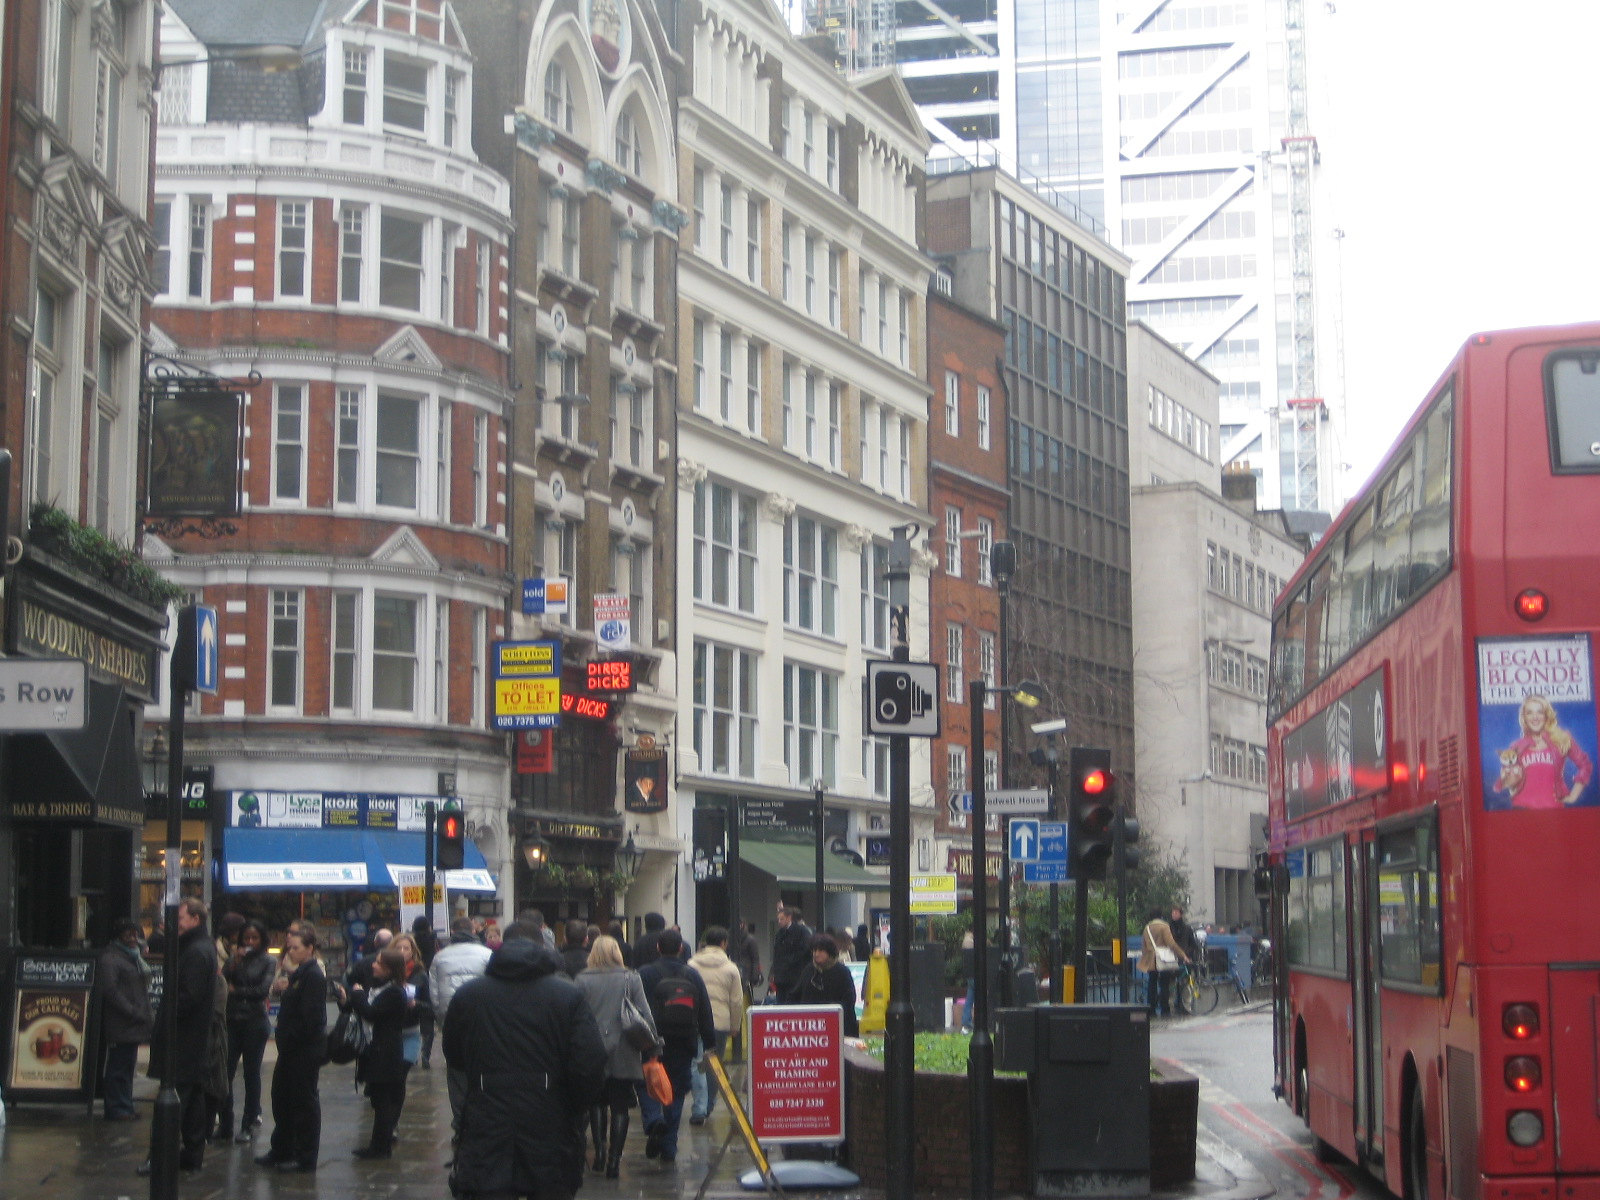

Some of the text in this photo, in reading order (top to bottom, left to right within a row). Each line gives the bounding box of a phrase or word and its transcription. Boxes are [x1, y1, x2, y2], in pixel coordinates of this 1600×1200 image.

[524, 587, 543, 598] sold
[23, 600, 147, 685] WOODIN'S SHADES
[1487, 648, 1580, 667] LEGALLY
[1488, 666, 1583, 685] BLONDE
[588, 676, 630, 689] DICKS
[17, 682, 75, 703] Row
[502, 691, 522, 705] TO
[527, 690, 555, 704] LET
[1490, 684, 1584, 699] THE MUSICAL
[576, 697, 608, 718] DICKS
[497, 715, 513, 726] 020
[289, 795, 321, 807] Lyca
[325, 797, 358, 809] KIOSK
[368, 798, 396, 811] KIOSK
[987, 795, 1046, 806] odwell House
[13, 803, 91, 816] BAR & DINING
[289, 806, 321, 815] mobile
[23, 959, 89, 974] BREAKFAST
[36, 996, 70, 1006] PROUD OF
[25, 1003, 80, 1021] OUR CASK ALES
[766, 1018, 827, 1032] PICTURE
[763, 1036, 829, 1049] FRAMING
[764, 1057, 829, 1069] CITY ART AND
[774, 1068, 819, 1078] FRAMING
[769, 1099, 783, 1108] 020
